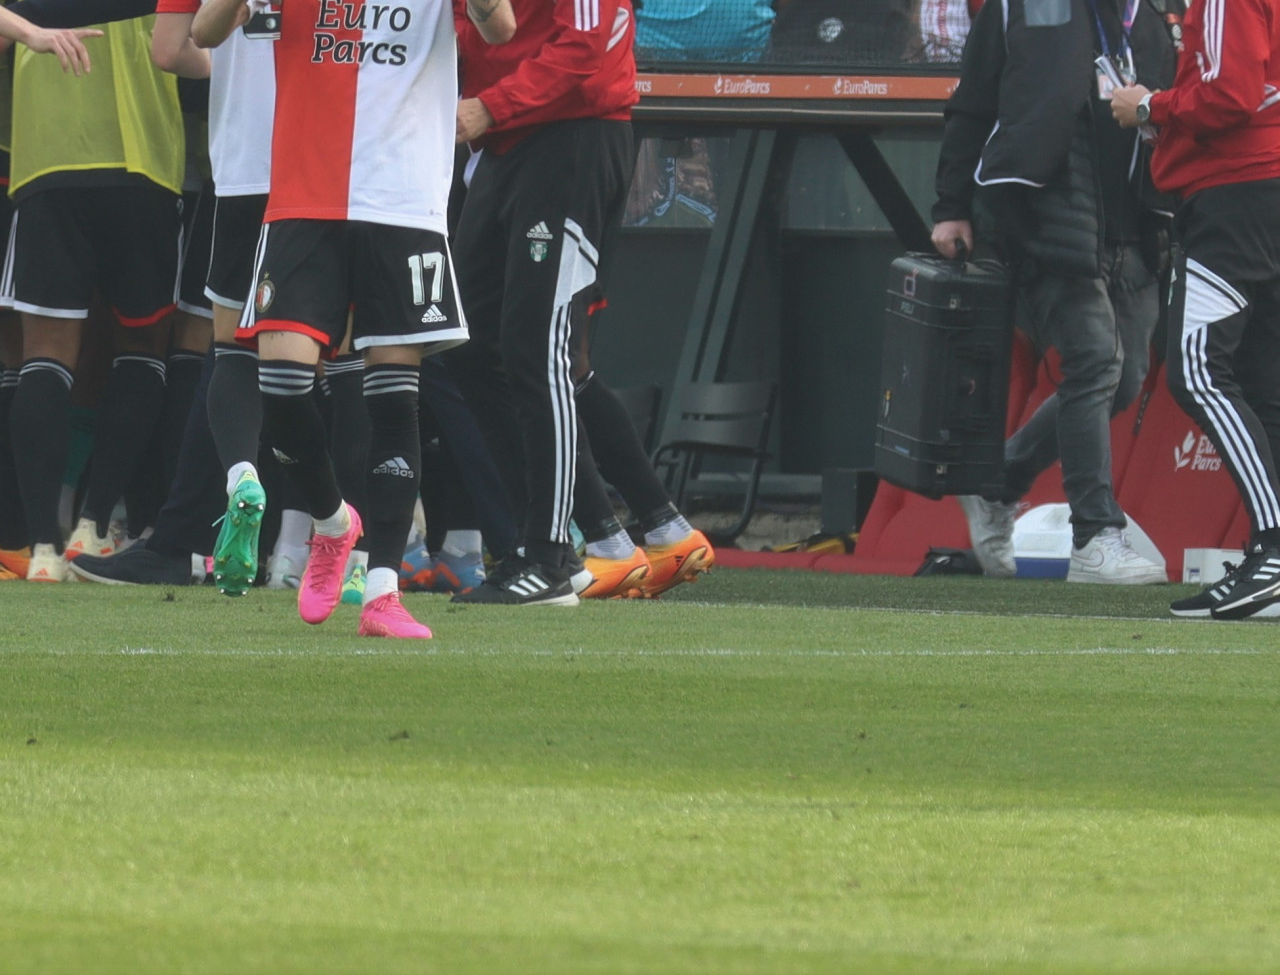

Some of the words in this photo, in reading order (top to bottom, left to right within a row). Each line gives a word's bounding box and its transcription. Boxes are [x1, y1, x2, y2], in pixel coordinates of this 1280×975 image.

[311, 32, 409, 67] Parcs
[723, 78, 770, 94] EuroParcs
[843, 79, 888, 95] EuroParcs
[526, 229, 553, 240] adidas
[407, 251, 446, 306] 17
[421, 313, 448, 324] adidas
[1191, 454, 1222, 472] Parcs
[372, 464, 415, 479] adidas
